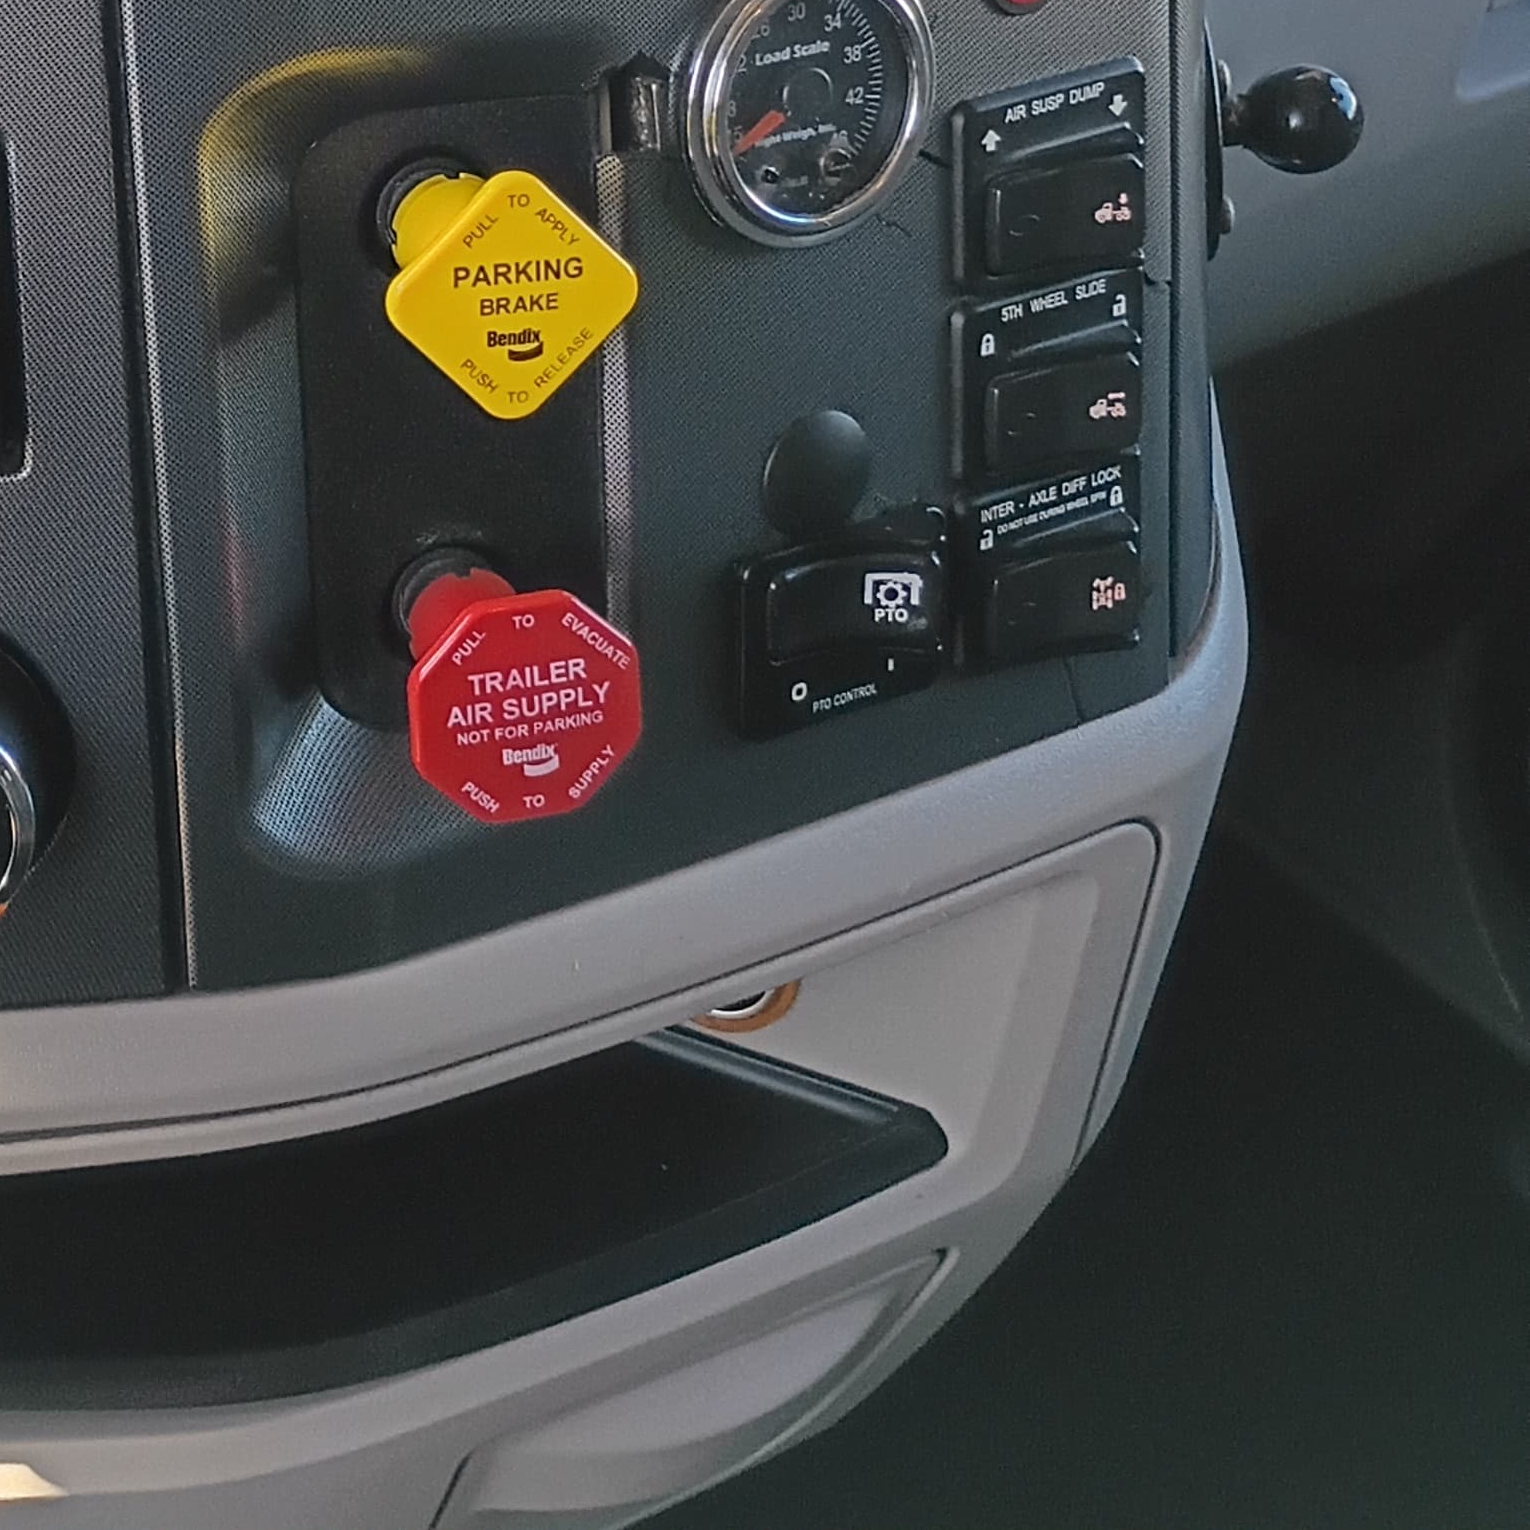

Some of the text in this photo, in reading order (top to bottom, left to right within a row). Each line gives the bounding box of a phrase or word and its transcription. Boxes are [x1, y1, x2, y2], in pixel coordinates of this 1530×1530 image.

[788, 2, 806, 22] 30
[824, 12, 842, 31] 34
[755, 39, 830, 66] Load Scale
[843, 44, 862, 64] 38
[845, 86, 864, 105] 42
[1004, 81, 1105, 123] AIR SUSP DUMP
[462, 194, 581, 249] PULL TO APPLY
[453, 256, 584, 289] PARKING
[480, 292, 559, 316] BRAKE
[1001, 279, 1107, 322] 5TH WHEEL SLIDE
[486, 327, 541, 348] Bendix
[460, 326, 595, 404] PUSH TO RELEASE
[980, 500, 1016, 523] INTER
[1028, 486, 1058, 507] AXLE
[1062, 476, 1087, 496] DIFF
[1091, 465, 1122, 487] LOCK
[874, 608, 909, 622] PTO
[452, 612, 631, 670] PULL TO EVACUATE
[467, 658, 588, 696] TRAILER
[447, 681, 611, 728] AIR SUPPLY
[812, 683, 877, 714] PTO CONTROL
[456, 710, 604, 746] NOT FOR PARKING
[502, 743, 556, 766] Bendix
[460, 744, 616, 814] PUSH TO SUPPLY
